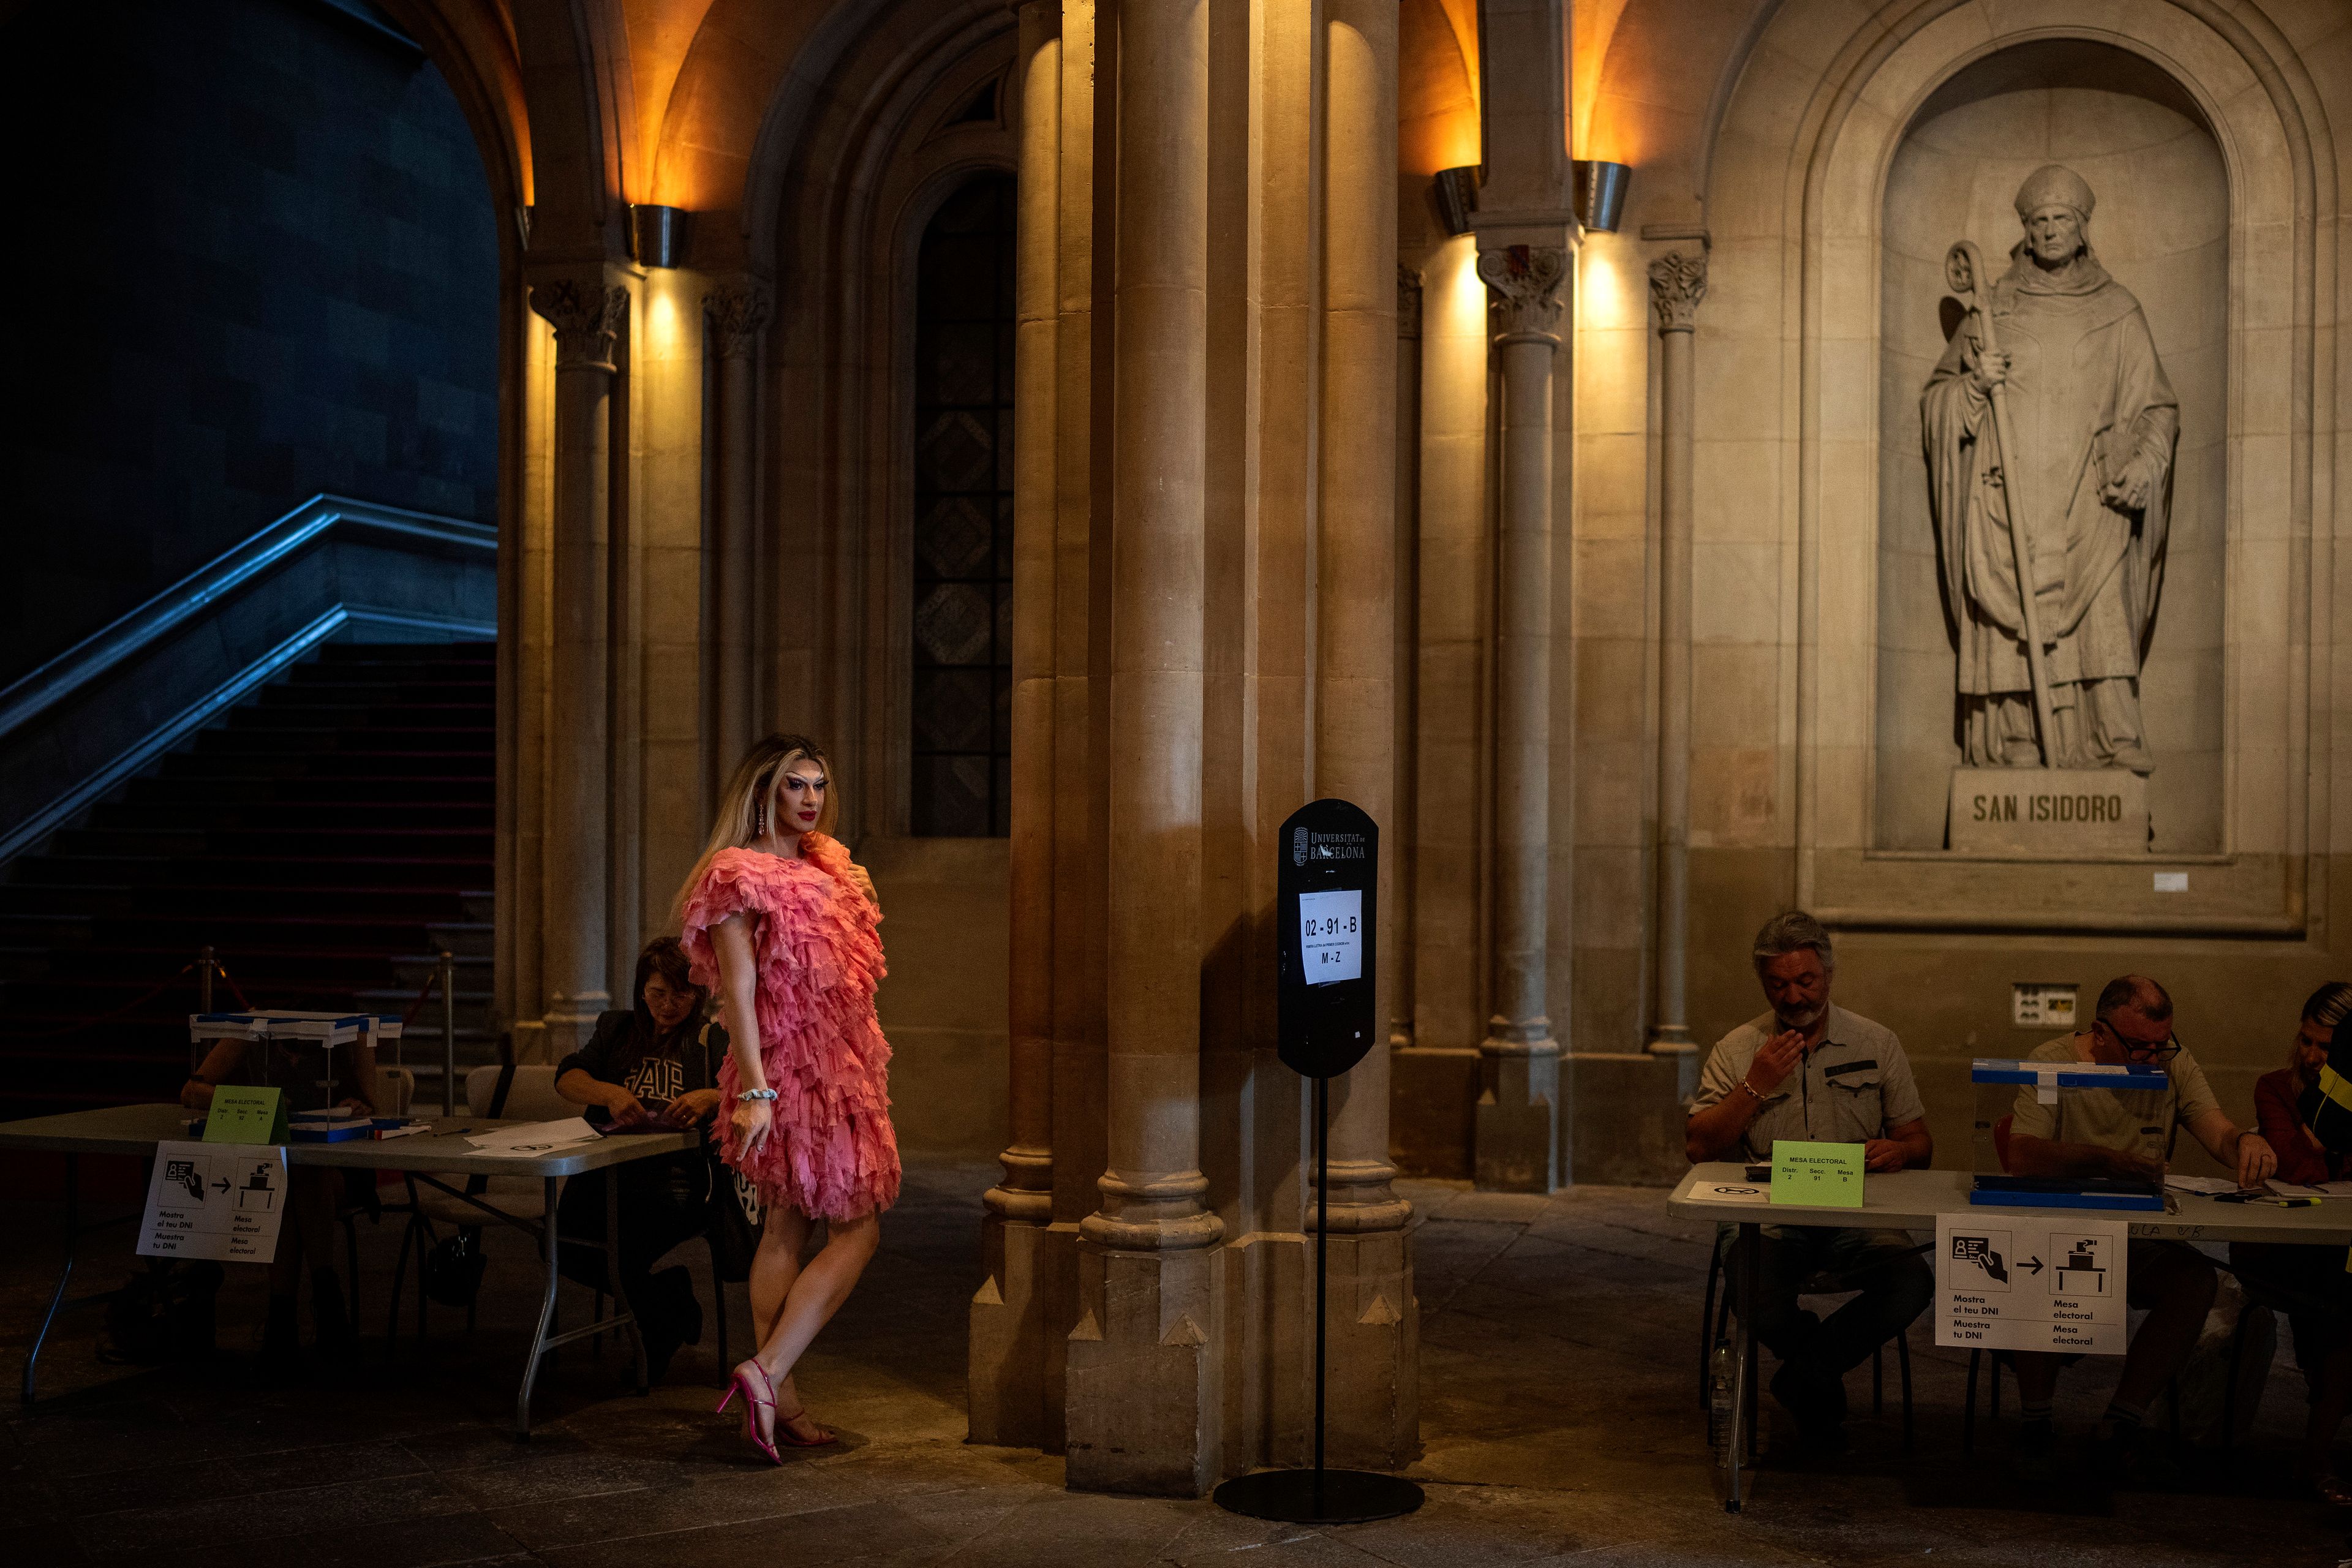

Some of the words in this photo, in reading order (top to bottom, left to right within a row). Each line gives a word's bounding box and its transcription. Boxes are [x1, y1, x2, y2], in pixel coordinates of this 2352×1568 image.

[1973, 795, 2017, 822] SAN
[2029, 795, 2121, 822] ISIDORO
[1311, 832, 1360, 844] UNIVERSITAT
[1311, 846, 1365, 859] BARCELONA
[1306, 919, 1316, 937] 02
[1327, 918, 1338, 935] 91
[1350, 916, 1357, 933] B
[1322, 952, 1329, 964] M
[1335, 951, 1341, 963] Z
[1954, 1294, 1985, 1303] Mostra
[2054, 1300, 2078, 1308] Mesa
[2054, 1310, 2093, 1320] electoral
[1954, 1320, 1990, 1329] Muestra
[1966, 1331, 1982, 1340] DNI
[2053, 1336, 2093, 1345] electoral
